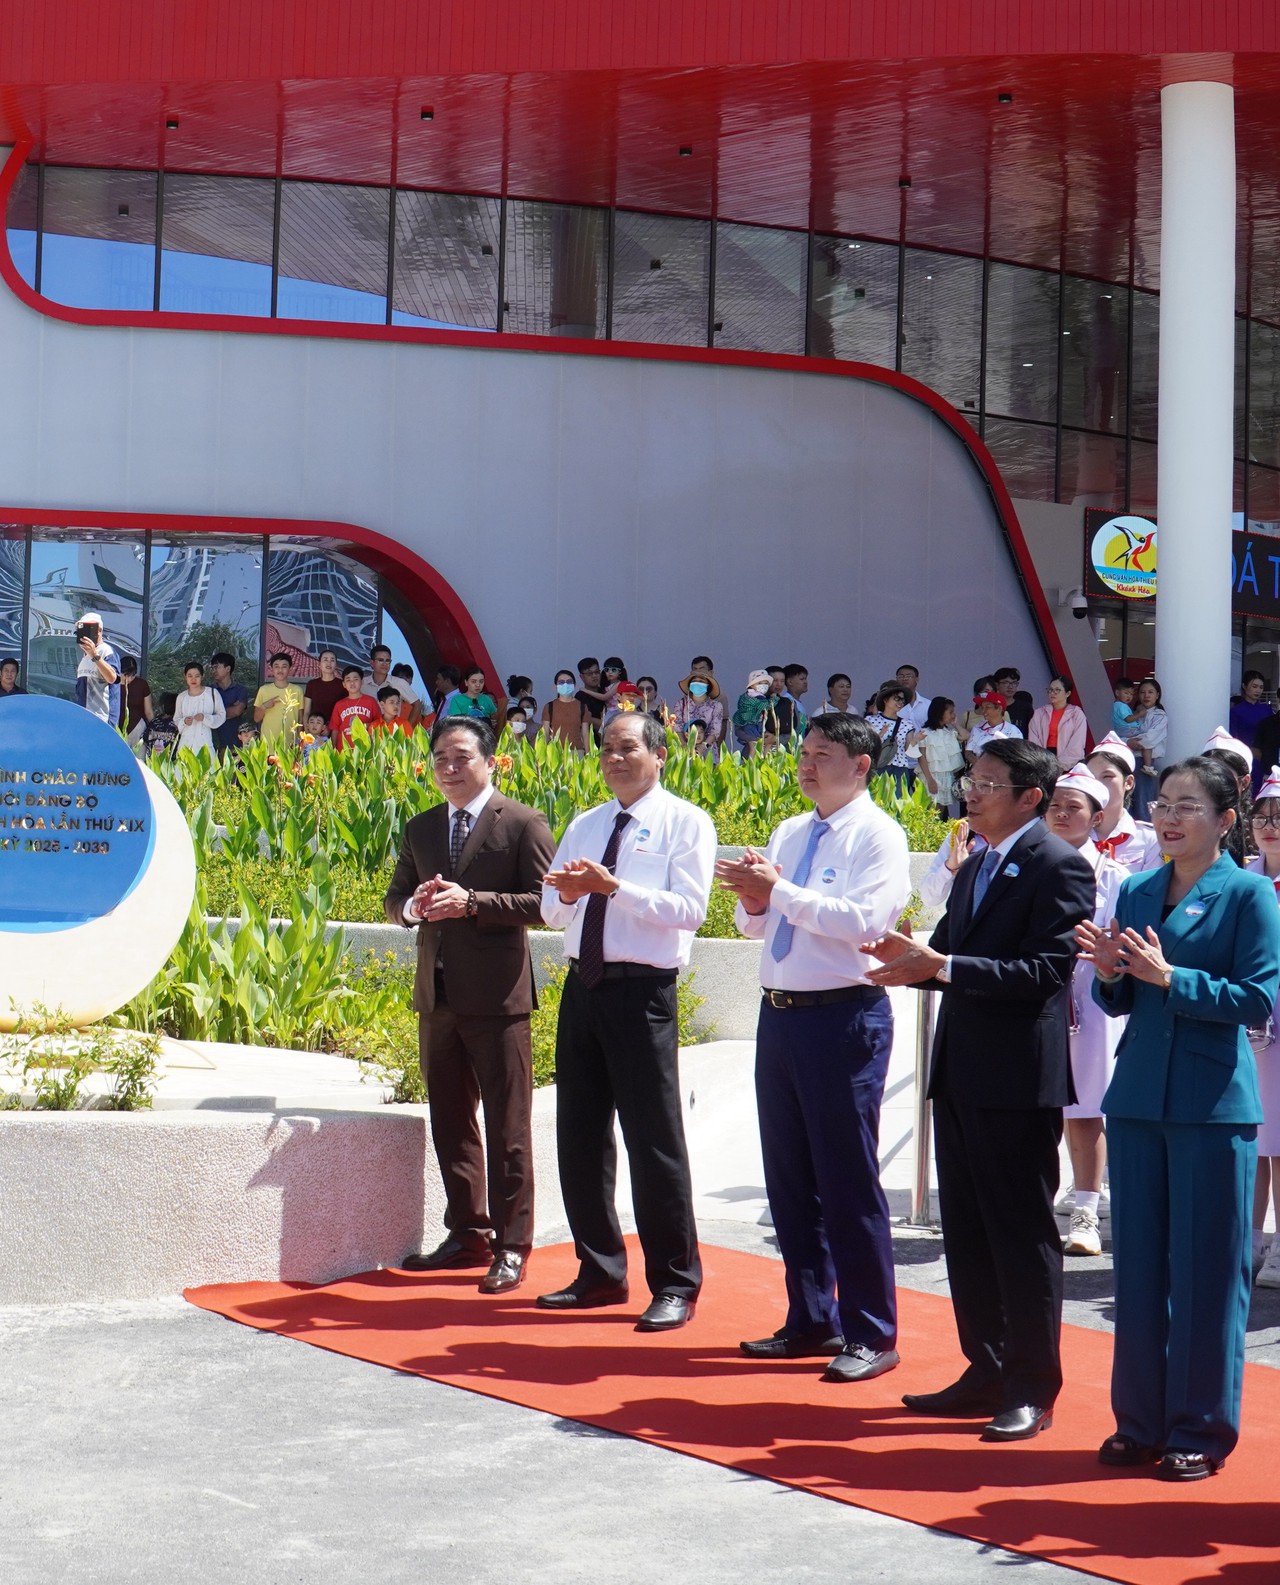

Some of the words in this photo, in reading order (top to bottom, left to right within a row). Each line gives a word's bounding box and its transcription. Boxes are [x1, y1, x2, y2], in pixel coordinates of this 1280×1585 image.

[1232, 541, 1260, 596] Á
[31, 768, 78, 785] CHÀO
[82, 769, 131, 787] MỪNG
[25, 789, 72, 808] ĐẢNG
[75, 793, 99, 812] BỘ
[11, 811, 47, 829] HÒA
[50, 811, 80, 830] LẦN
[84, 814, 115, 831] THỨ
[117, 818, 146, 832] XIX
[24, 838, 61, 853] 2025
[73, 840, 111, 855] 2030
